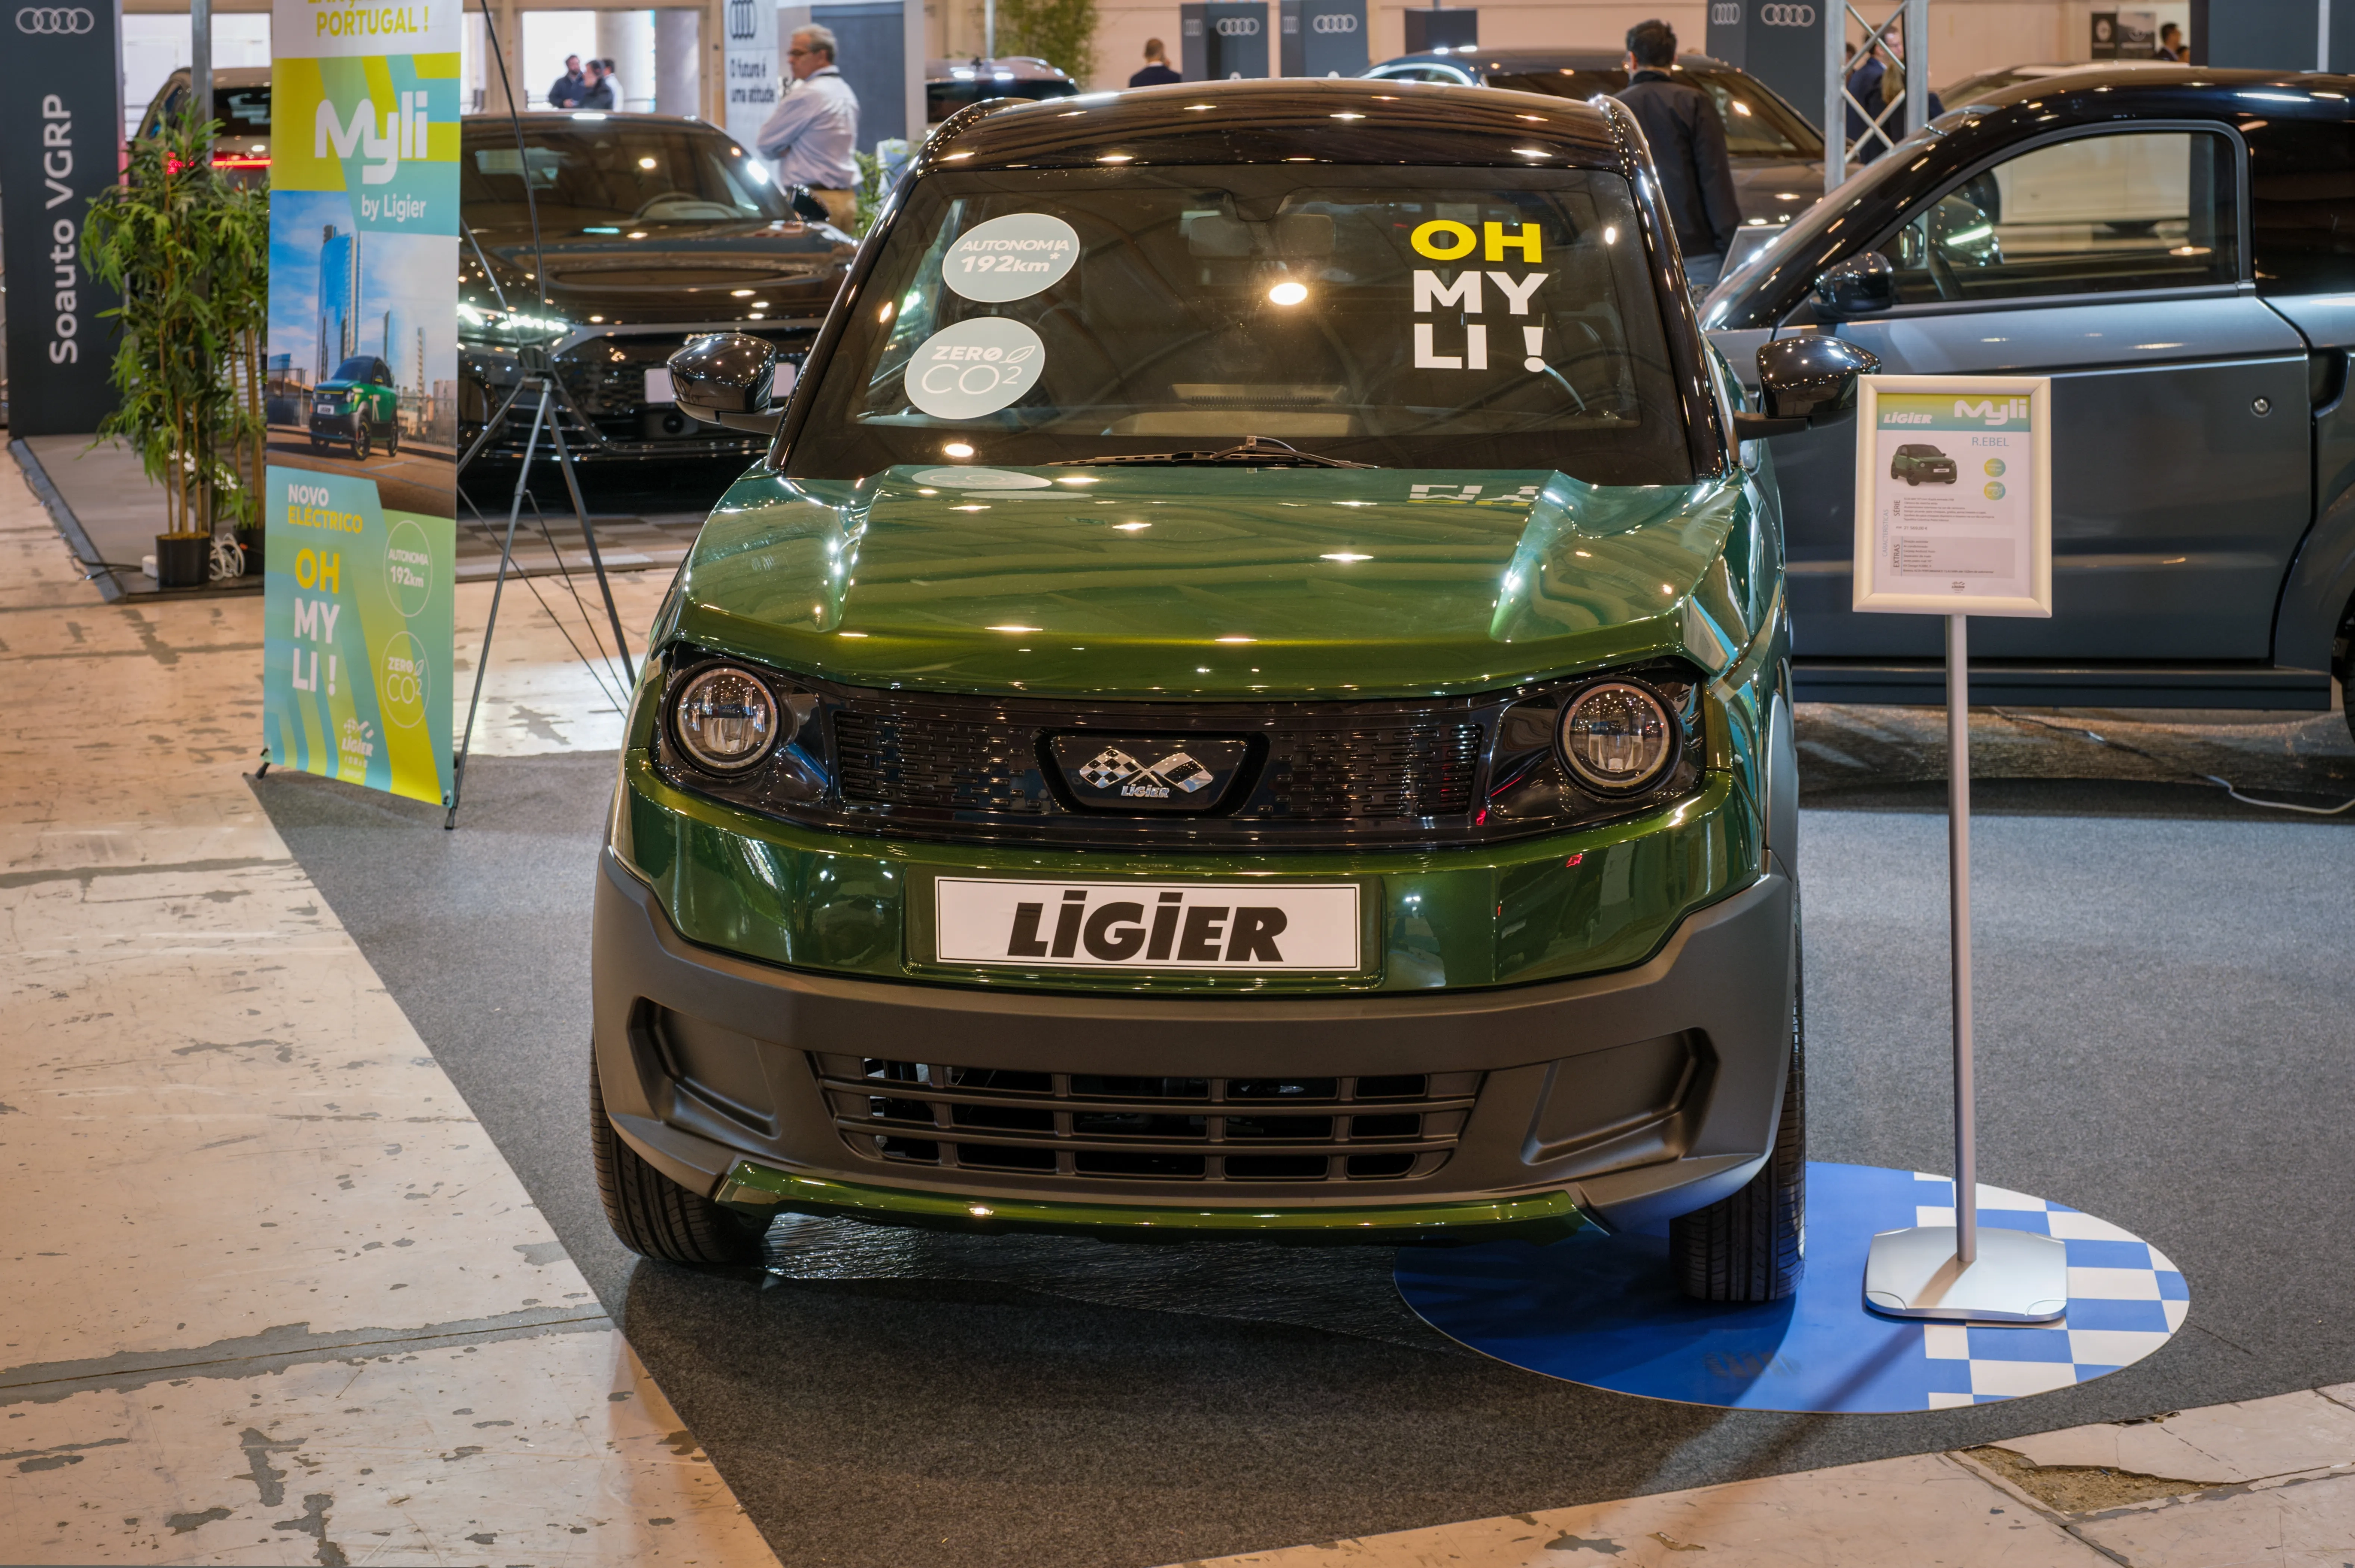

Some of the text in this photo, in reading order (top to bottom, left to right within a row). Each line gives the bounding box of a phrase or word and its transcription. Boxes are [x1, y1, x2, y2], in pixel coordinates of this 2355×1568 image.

[317, 7, 417, 37] PORTUGAL
[315, 91, 428, 184] Myli
[361, 193, 427, 223] by Ligier
[42, 94, 78, 364] Soauto VGRP
[959, 240, 1069, 252] AUTONOMIA
[1411, 219, 1542, 263] OH
[1414, 270, 1549, 315] MY
[1414, 323, 1546, 372] LI !
[1954, 399, 2027, 425] Myli
[1972, 437, 2009, 447] R.EBEL
[288, 483, 329, 507] NOVO
[288, 502, 363, 534] ELÉCTRICO
[295, 548, 340, 594] OH
[388, 548, 429, 566] AUTONOMIA
[294, 597, 340, 644] MY
[292, 647, 337, 696] LI !
